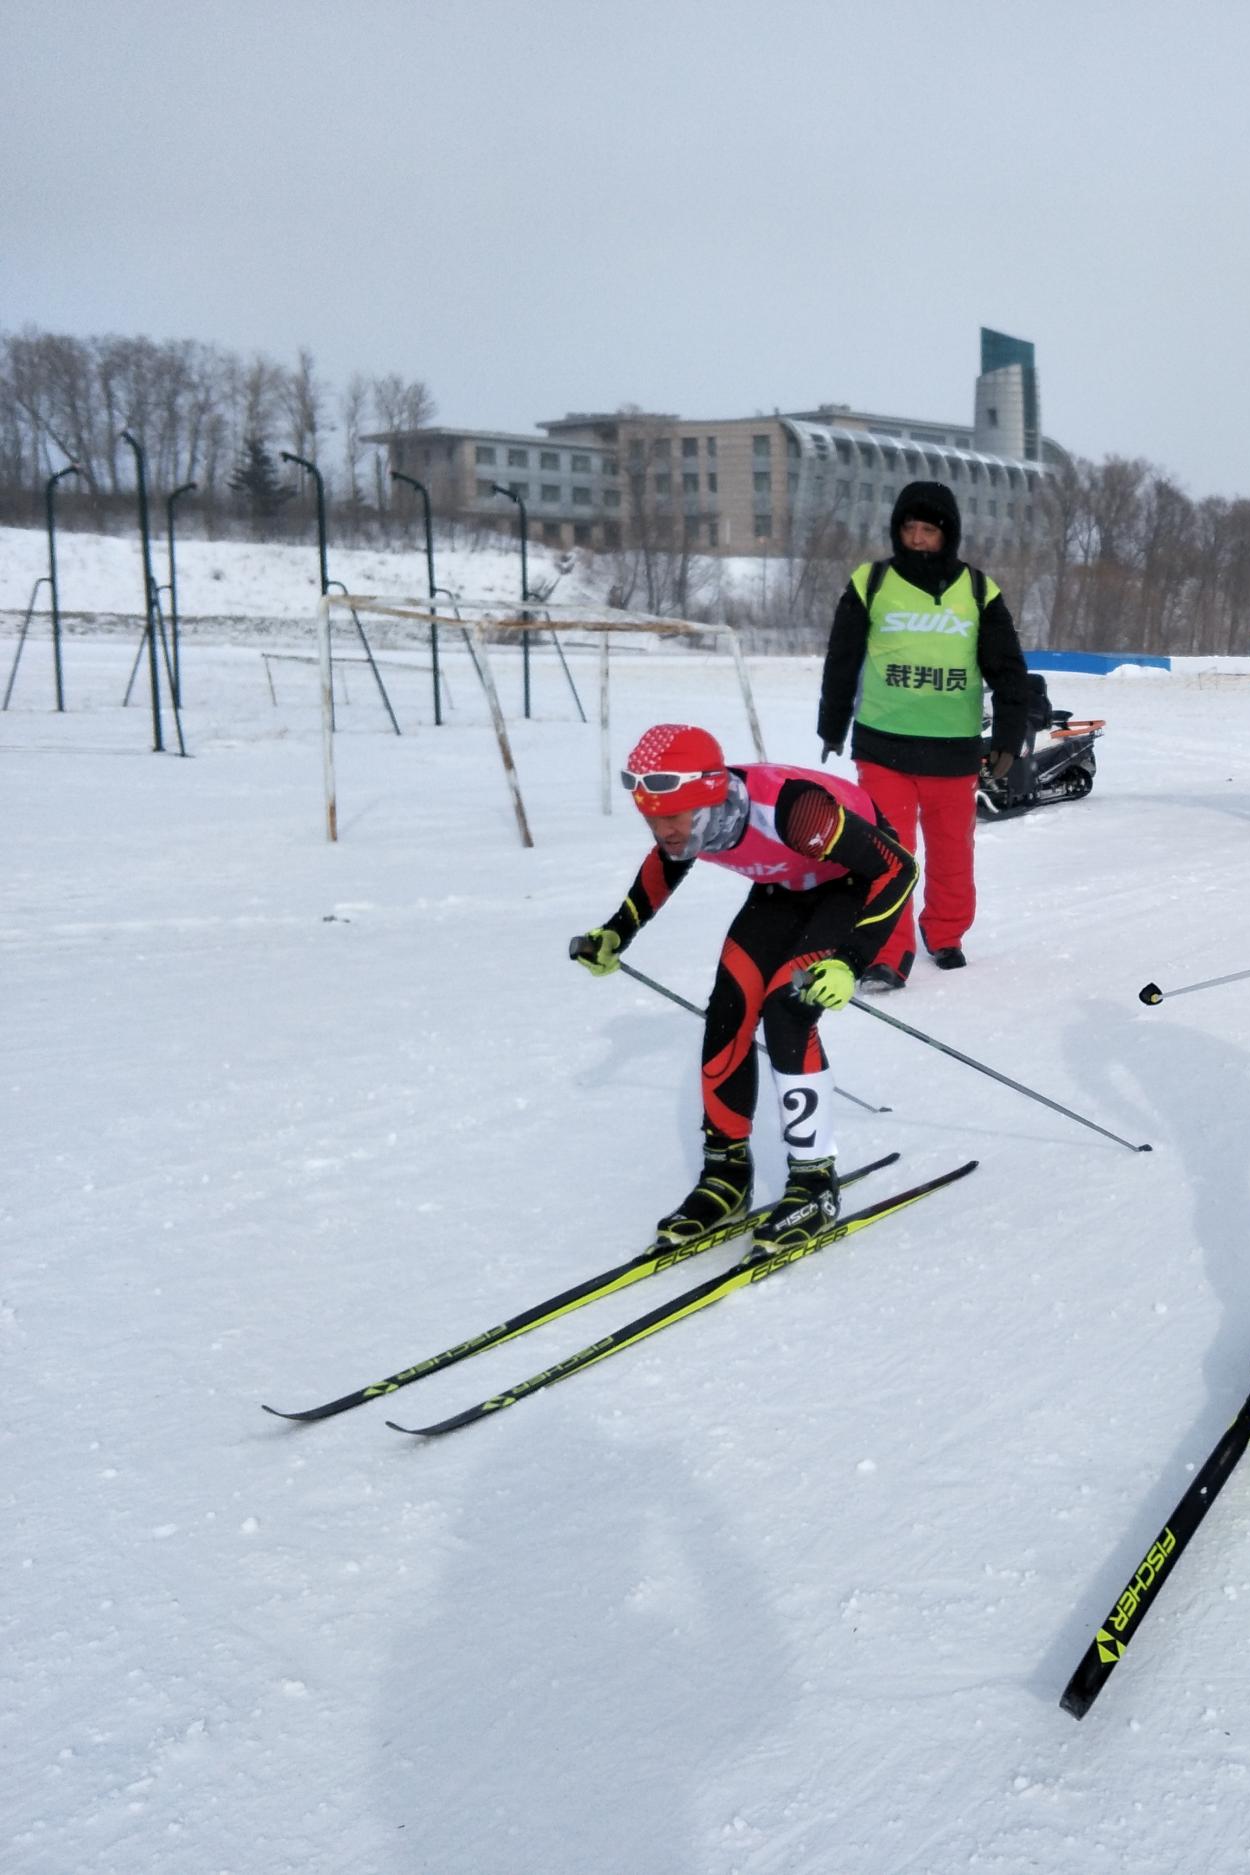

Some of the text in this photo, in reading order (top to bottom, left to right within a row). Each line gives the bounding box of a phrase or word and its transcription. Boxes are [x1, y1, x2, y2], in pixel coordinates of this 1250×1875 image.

[885, 663, 968, 692] 裁判员
[783, 1086, 819, 1148] 2
[654, 1217, 760, 1273] FISCHER
[751, 1225, 848, 1283] FISCHER
[395, 1323, 507, 1380] FISCHER
[512, 1335, 614, 1394] FISCHER
[1109, 1527, 1176, 1631] FISCHER
